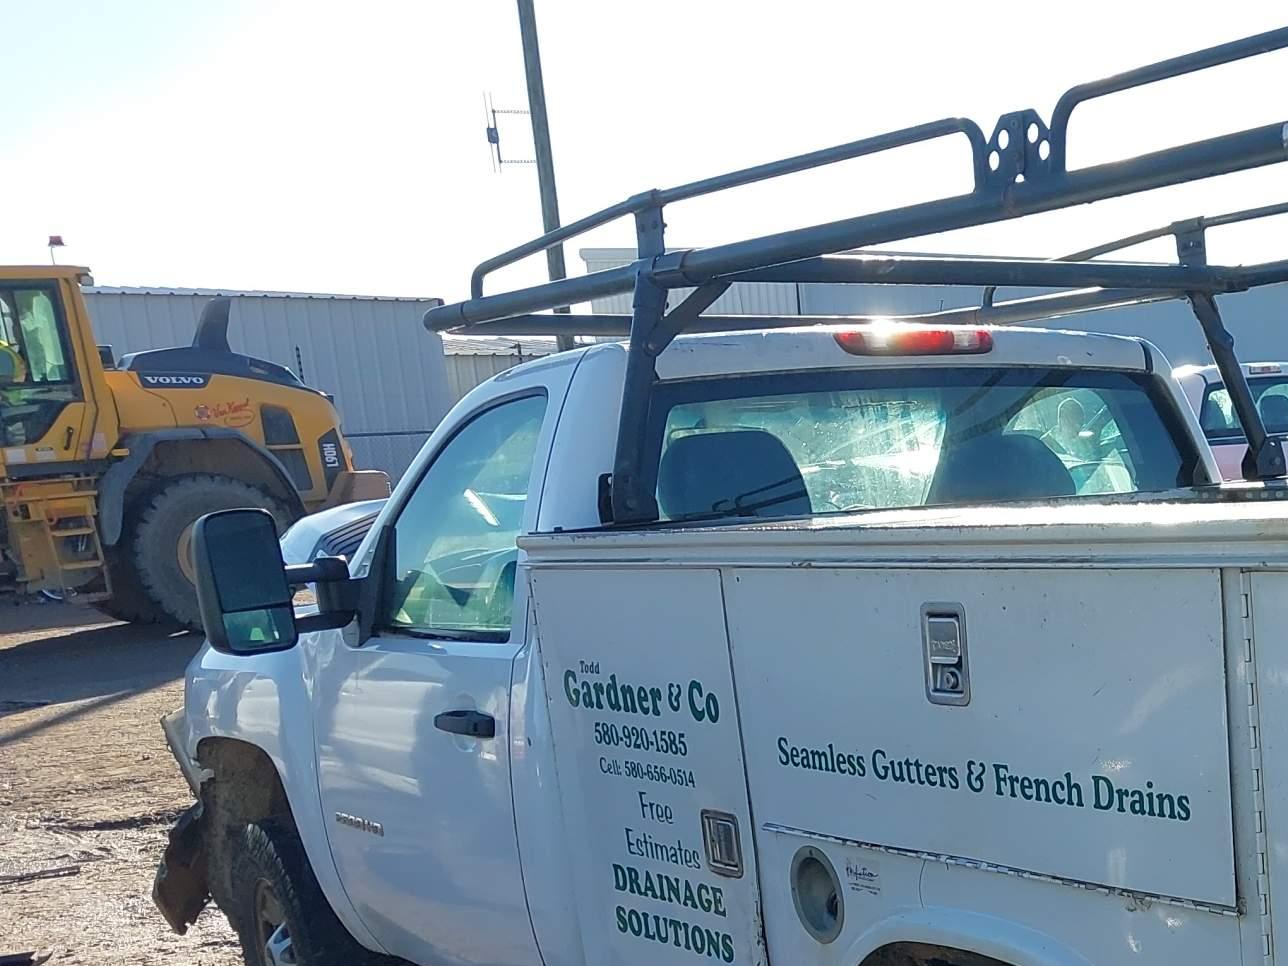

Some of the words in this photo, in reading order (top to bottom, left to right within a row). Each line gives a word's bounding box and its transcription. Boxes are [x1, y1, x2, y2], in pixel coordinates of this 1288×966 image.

[144, 376, 205, 385] VOLVO
[322, 443, 340, 469] L90H
[579, 660, 600, 675] Todd
[563, 669, 662, 717] Gardner
[667, 682, 682, 712] &
[687, 680, 721, 724] Co
[593, 722, 688, 757] 580-920-1585
[599, 757, 622, 777] Cell:
[624, 763, 696, 789] 580-656-0514
[777, 736, 867, 778] Seamless
[871, 748, 960, 791] Gutters
[966, 759, 987, 794] &
[992, 763, 1085, 809] French
[1091, 775, 1192, 822] Drains
[638, 791, 674, 825] Free
[624, 827, 702, 870] Estimates
[612, 863, 727, 917] DRAINAGE
[615, 905, 735, 964] SOLUTIONS
